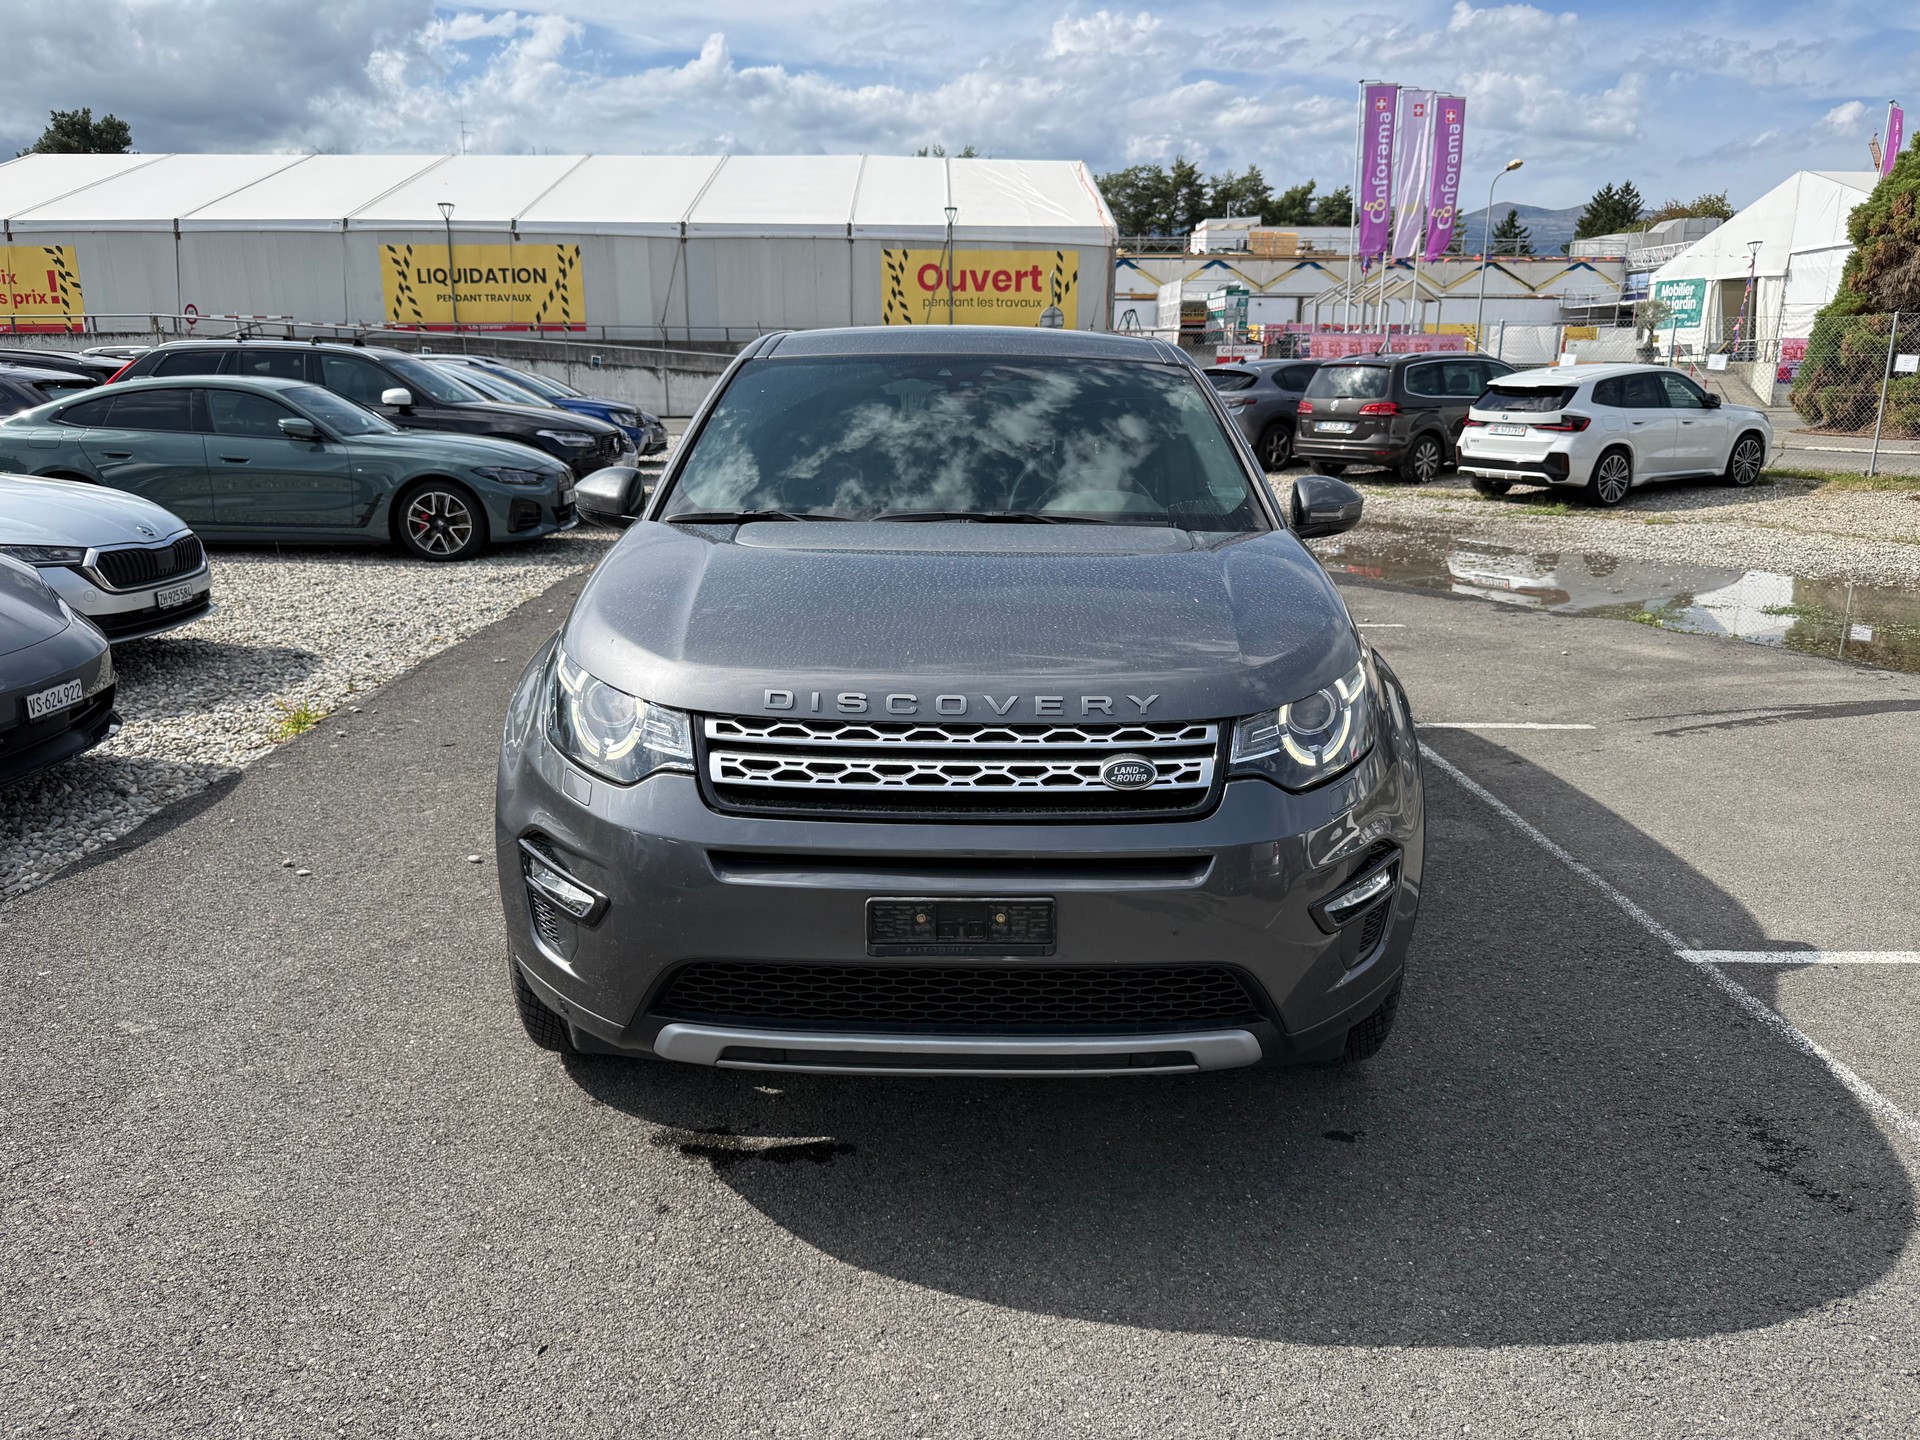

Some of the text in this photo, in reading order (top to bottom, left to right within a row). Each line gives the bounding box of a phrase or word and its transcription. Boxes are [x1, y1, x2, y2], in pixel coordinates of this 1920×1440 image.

[1365, 112, 1391, 224] Conforama
[1434, 123, 1460, 230] Conforama
[416, 267, 548, 287] LIQUIDATION
[917, 263, 1043, 293] Ouvert
[436, 293, 532, 303] PENDANT TRAVAUX
[1661, 281, 1695, 297] Mobilier
[12, 288, 48, 309] prix
[922, 296, 1042, 310] pendant les travaux
[1670, 297, 1697, 314] jardin
[763, 688, 1161, 714] DISCOVERY
[1113, 766, 1139, 775] LAND
[1116, 773, 1147, 782] ROVER
